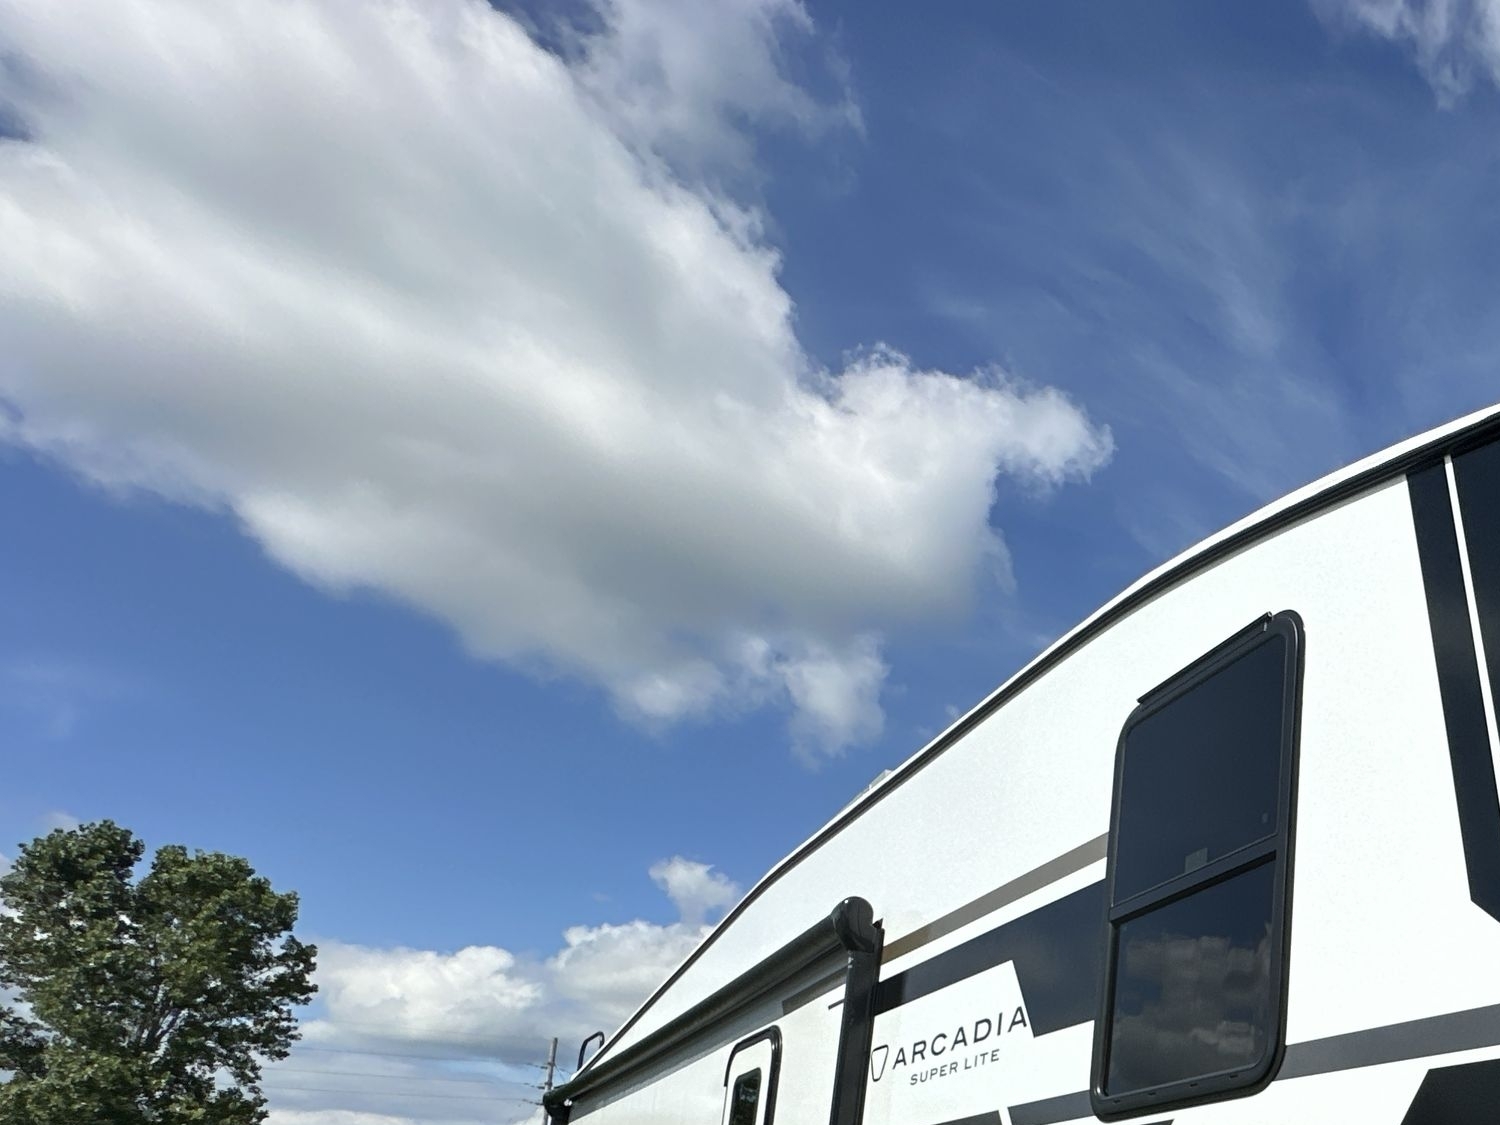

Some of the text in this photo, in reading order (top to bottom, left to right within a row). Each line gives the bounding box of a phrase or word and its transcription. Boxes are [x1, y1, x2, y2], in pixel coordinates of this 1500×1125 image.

[892, 1006, 1028, 1071] ARCADIA
[909, 1048, 1001, 1086] SUPER LITE
